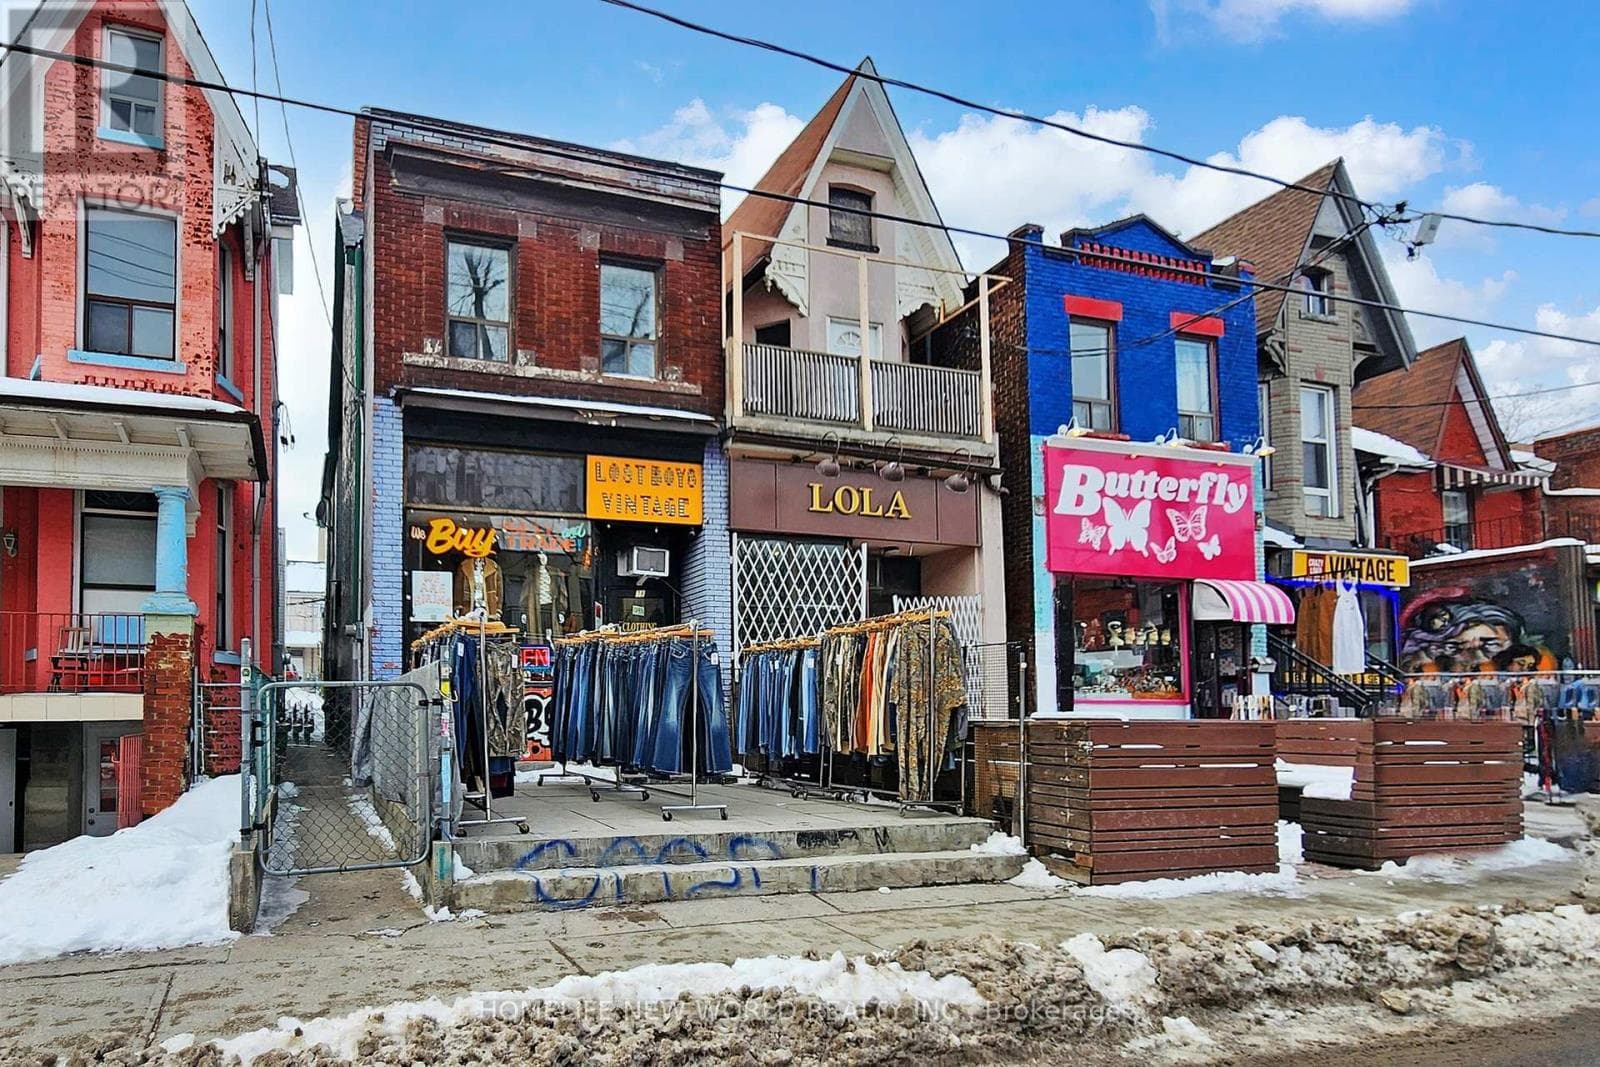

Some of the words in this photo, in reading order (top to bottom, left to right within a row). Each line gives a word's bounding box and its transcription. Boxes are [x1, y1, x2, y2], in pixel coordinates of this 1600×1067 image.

[595, 462, 646, 485] LOST
[651, 465, 697, 488] BOYS
[1055, 464, 1247, 515] Butterfly
[602, 492, 690, 518] VINTAGE
[808, 482, 912, 519] LOLA
[426, 518, 496, 557] Buy
[1329, 556, 1395, 582] VINTAGE
